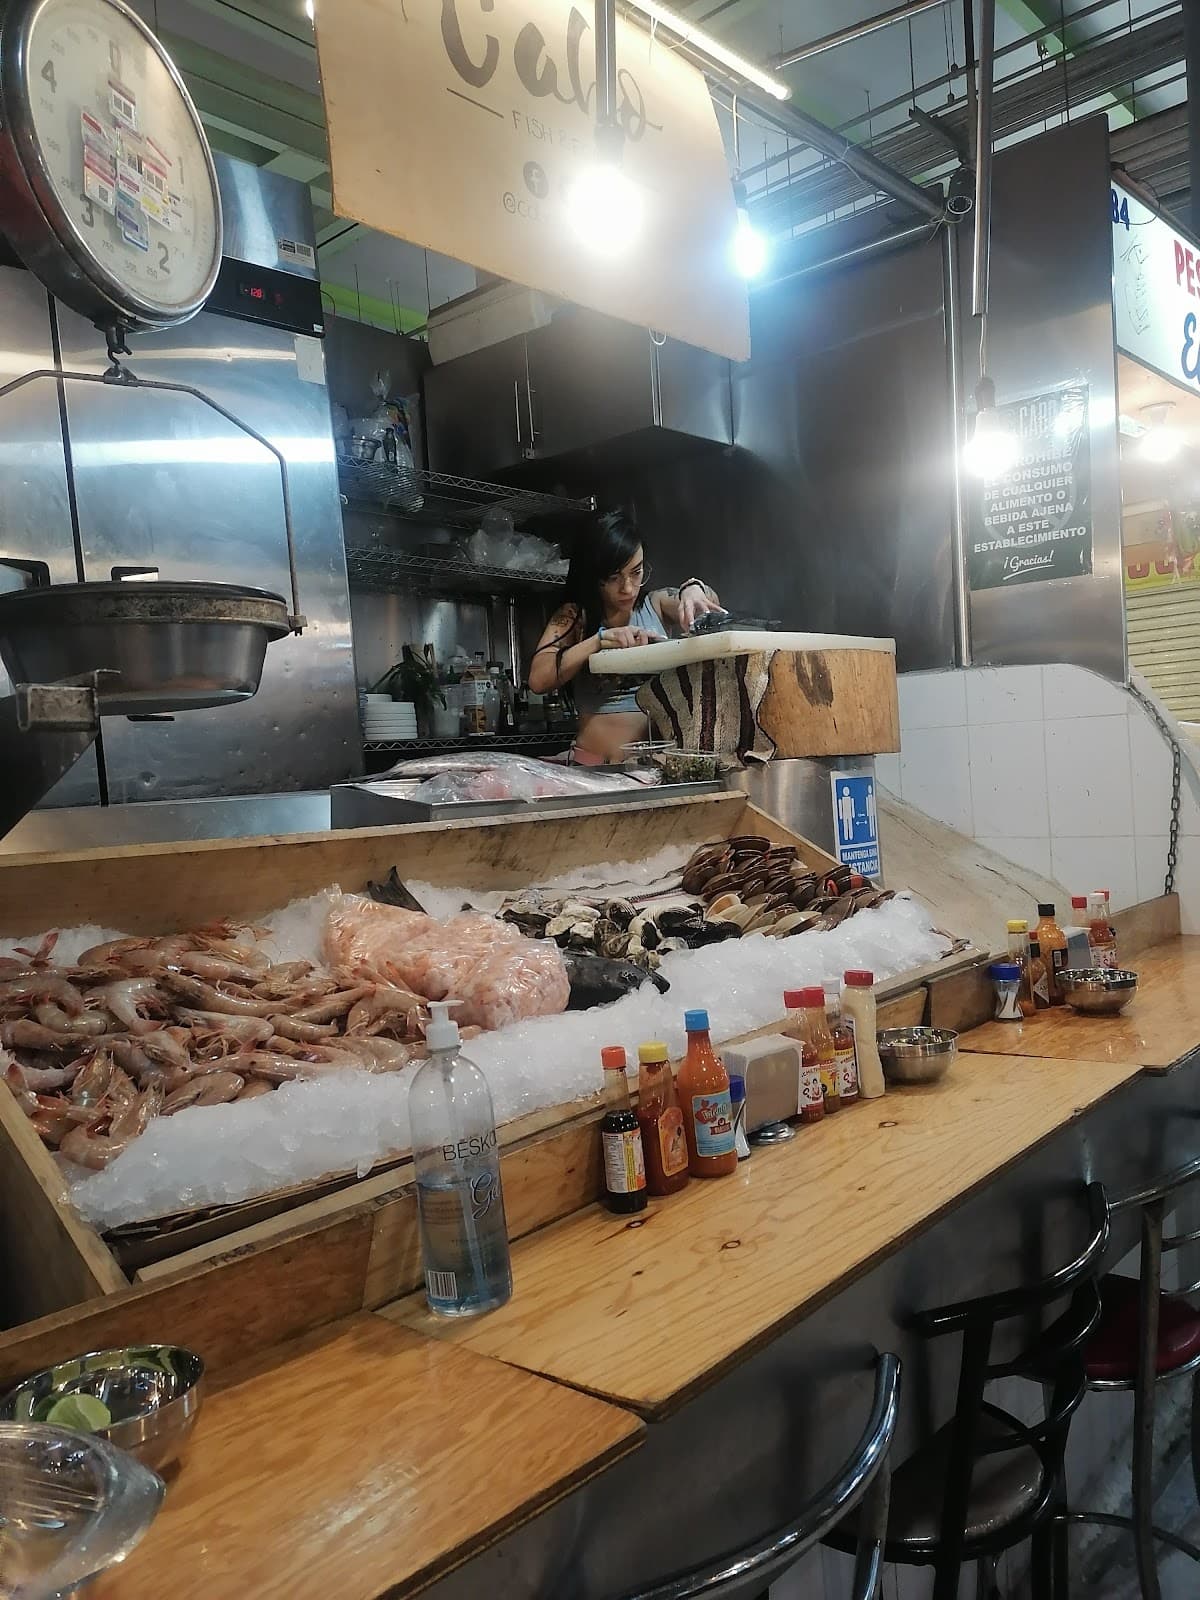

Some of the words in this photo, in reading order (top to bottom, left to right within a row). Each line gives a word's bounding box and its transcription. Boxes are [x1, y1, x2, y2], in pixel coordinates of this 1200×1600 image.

[41, 59, 57, 94] 4
[512, 110, 553, 144] FISH
[80, 194, 95, 229] 3
[157, 240, 172, 274] 2
[1003, 462, 1073, 483] CONSUMO
[984, 488, 999, 501] DE
[1002, 475, 1073, 498] CUALQUIER
[990, 492, 1053, 513] ALIMENTO
[1056, 490, 1066, 500] O
[984, 510, 1028, 527] BEBIDA
[1031, 502, 1074, 518] AJENA
[1006, 525, 1015, 535] A
[1018, 519, 1050, 532] ESTE
[974, 526, 1087, 554] ESTABLECIMIENTO
[1003, 550, 1055, 571] ¡Gracias!
[848, 858, 878, 875] ISTANCIA
